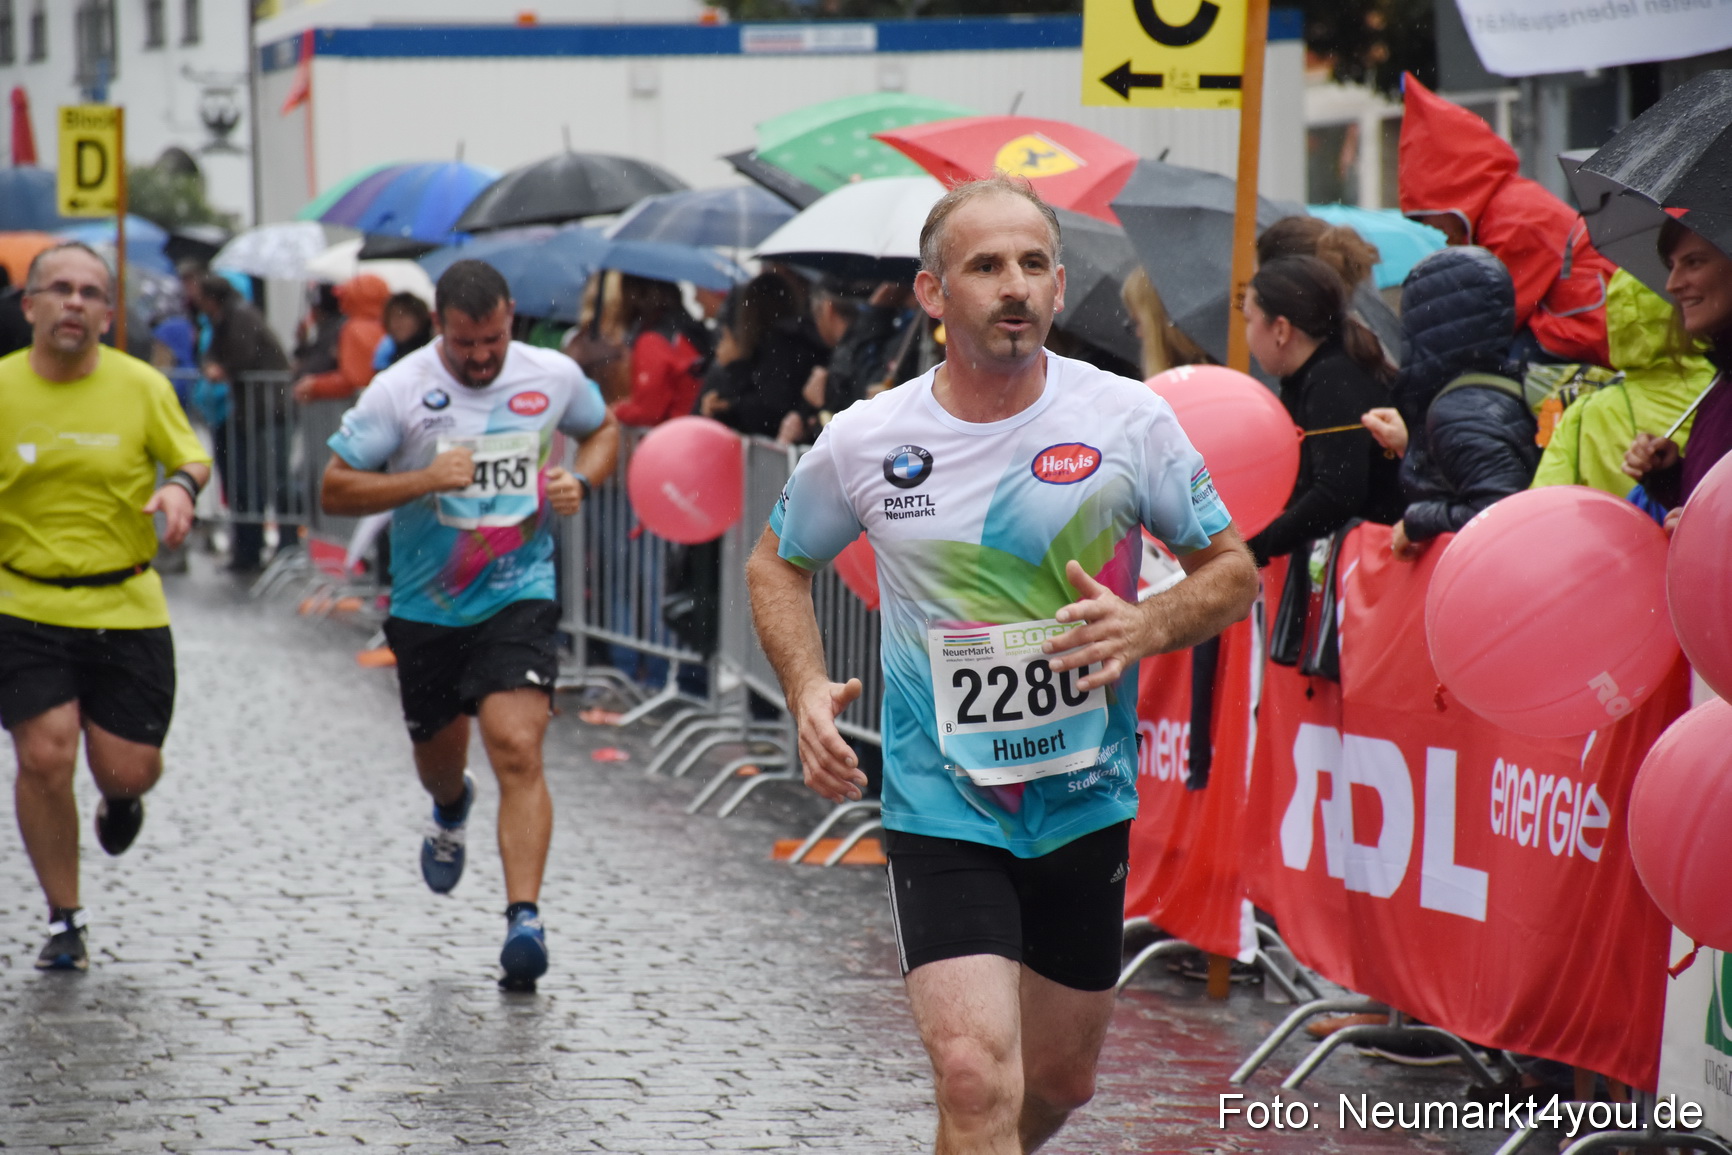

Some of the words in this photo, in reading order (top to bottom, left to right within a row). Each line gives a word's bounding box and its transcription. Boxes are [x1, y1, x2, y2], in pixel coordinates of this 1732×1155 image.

[76, 139, 108, 190] D
[886, 446, 930, 461] BMW
[1041, 454, 1094, 473] Hervis
[473, 456, 530, 491] 465
[884, 494, 936, 511] PARTL
[885, 507, 936, 520] Neumarkt
[942, 646, 995, 657] NeuerMarkt
[952, 659, 1090, 725] 2280
[945, 723, 953, 733] B
[993, 729, 1066, 761] Hubert
